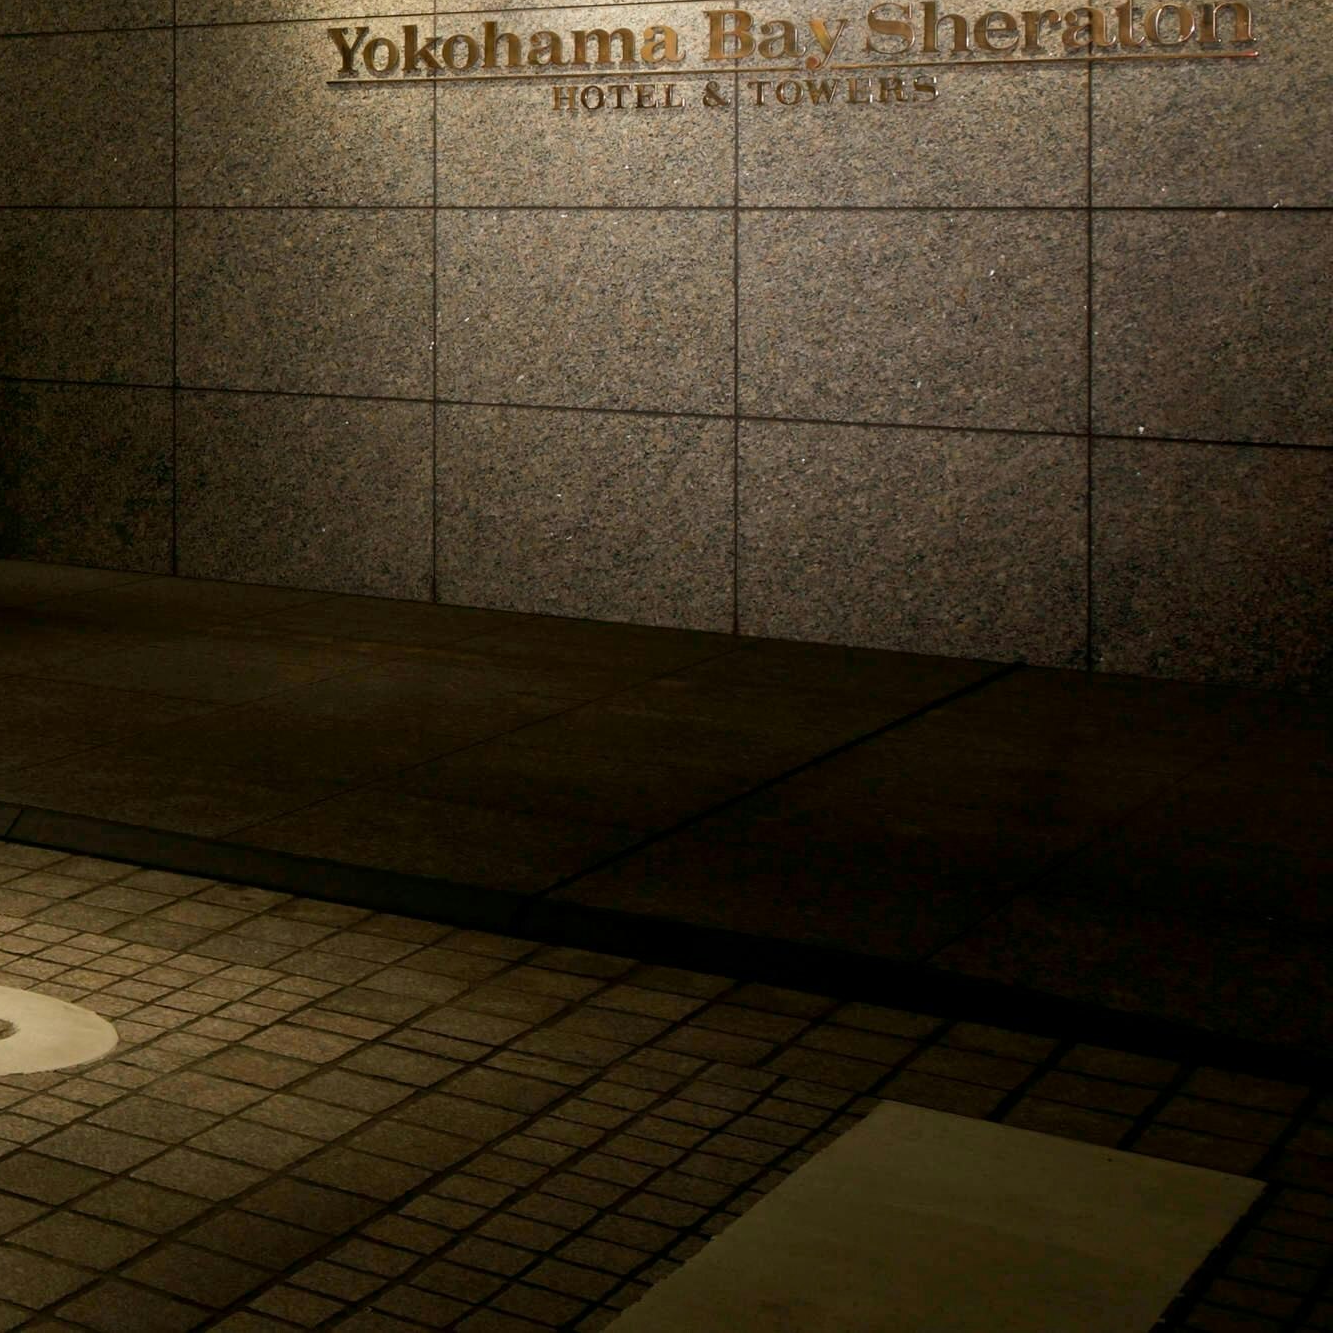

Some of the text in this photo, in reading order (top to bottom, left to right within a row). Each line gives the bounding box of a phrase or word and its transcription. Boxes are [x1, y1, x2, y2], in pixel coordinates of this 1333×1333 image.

[326, 20, 686, 78] Yokohama
[702, 8, 848, 70] Bay
[551, 74, 940, 111] HOTEL & TOWERS
